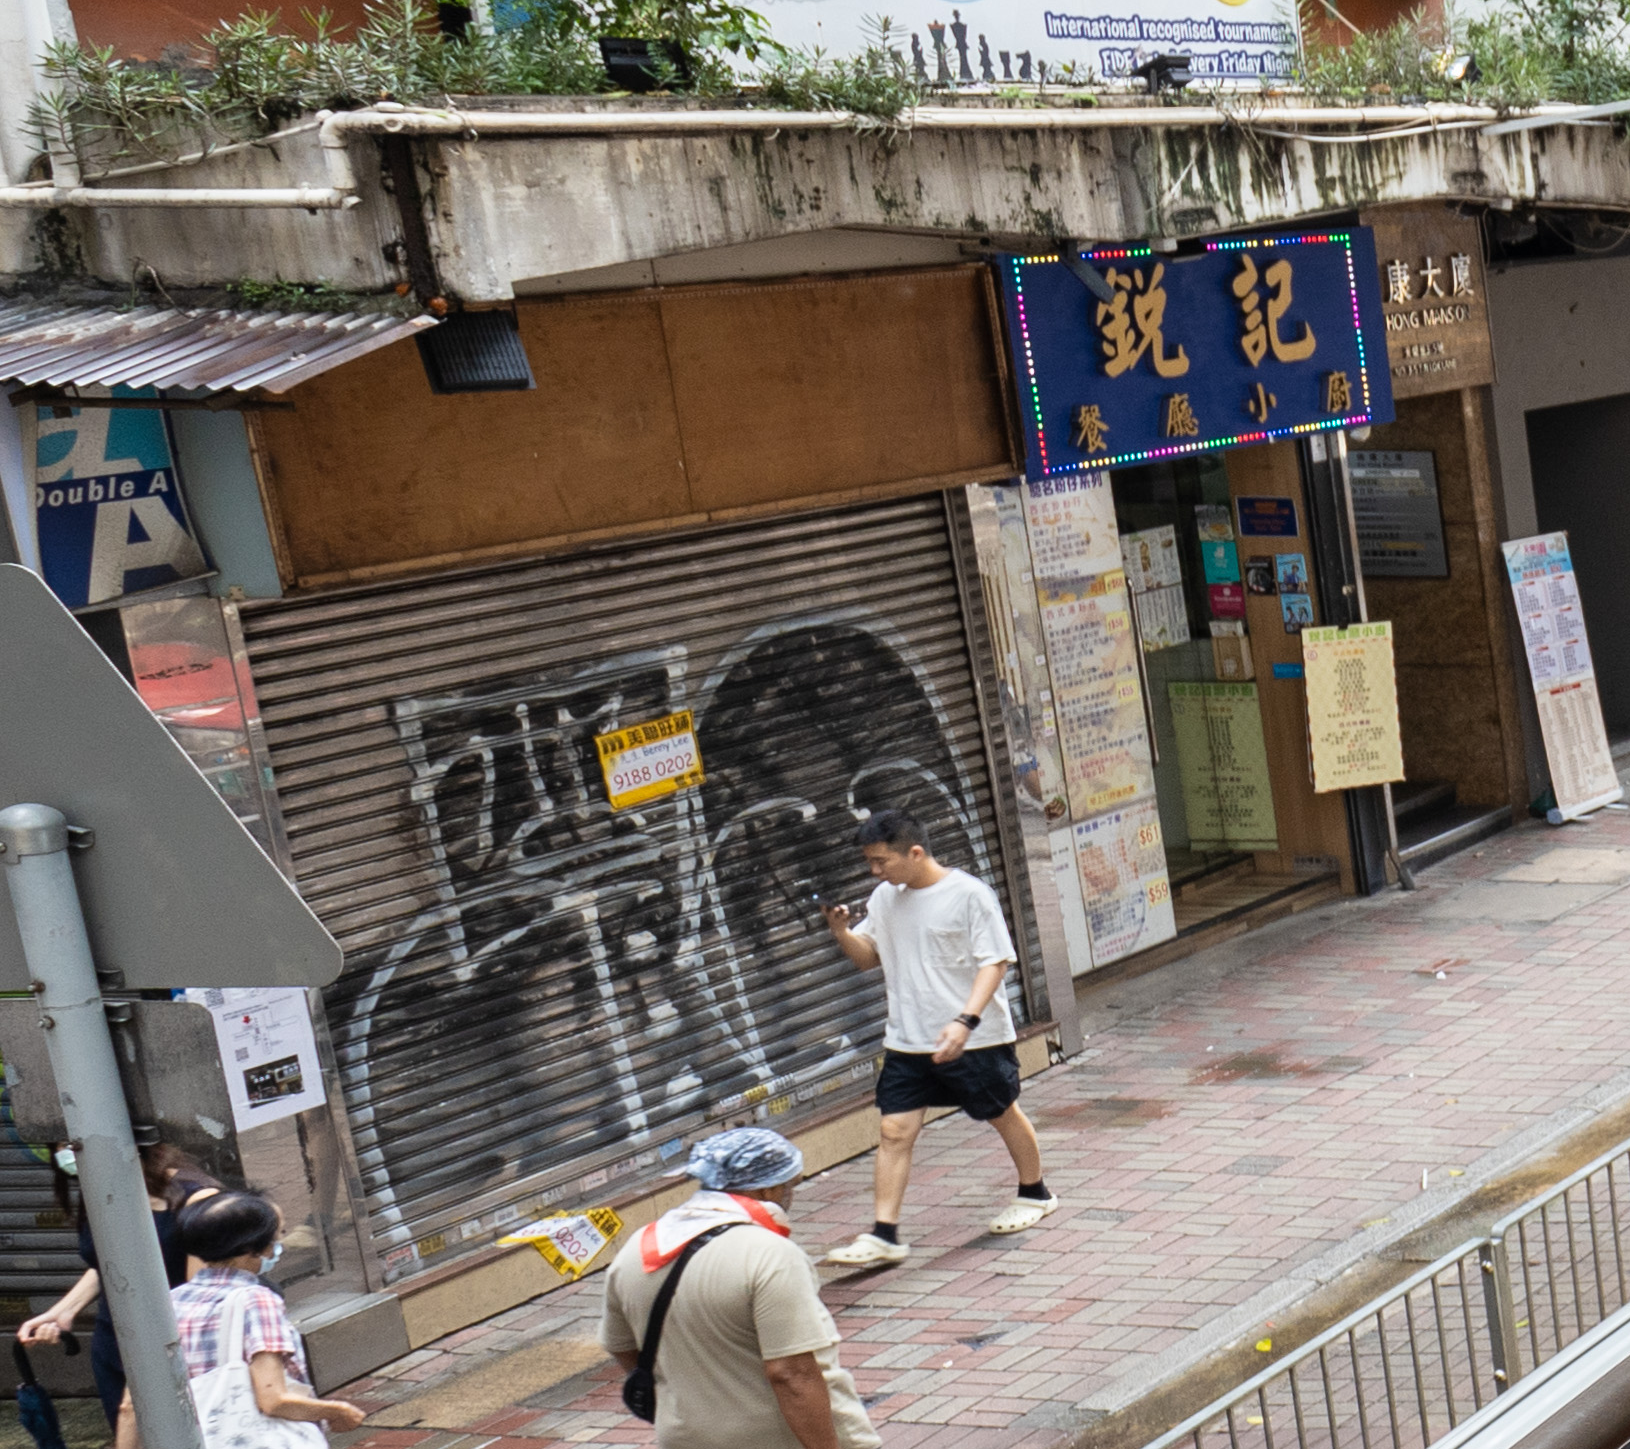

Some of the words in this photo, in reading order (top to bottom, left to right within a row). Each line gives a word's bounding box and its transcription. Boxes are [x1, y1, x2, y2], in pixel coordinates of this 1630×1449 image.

[1045, 11, 1141, 40] International
[1142, 17, 1217, 44] recognised
[1220, 50, 1262, 76] Friday
[1387, 252, 1475, 305] 康大廈
[1386, 310, 1419, 331] HONG
[1075, 369, 1355, 457] 餐廳小廚
[149, 470, 168, 493] A
[613, 766, 652, 791] 9188
[655, 752, 695, 777] 0202
[1139, 825, 1161, 846] $61
[1149, 882, 1169, 904] $59
